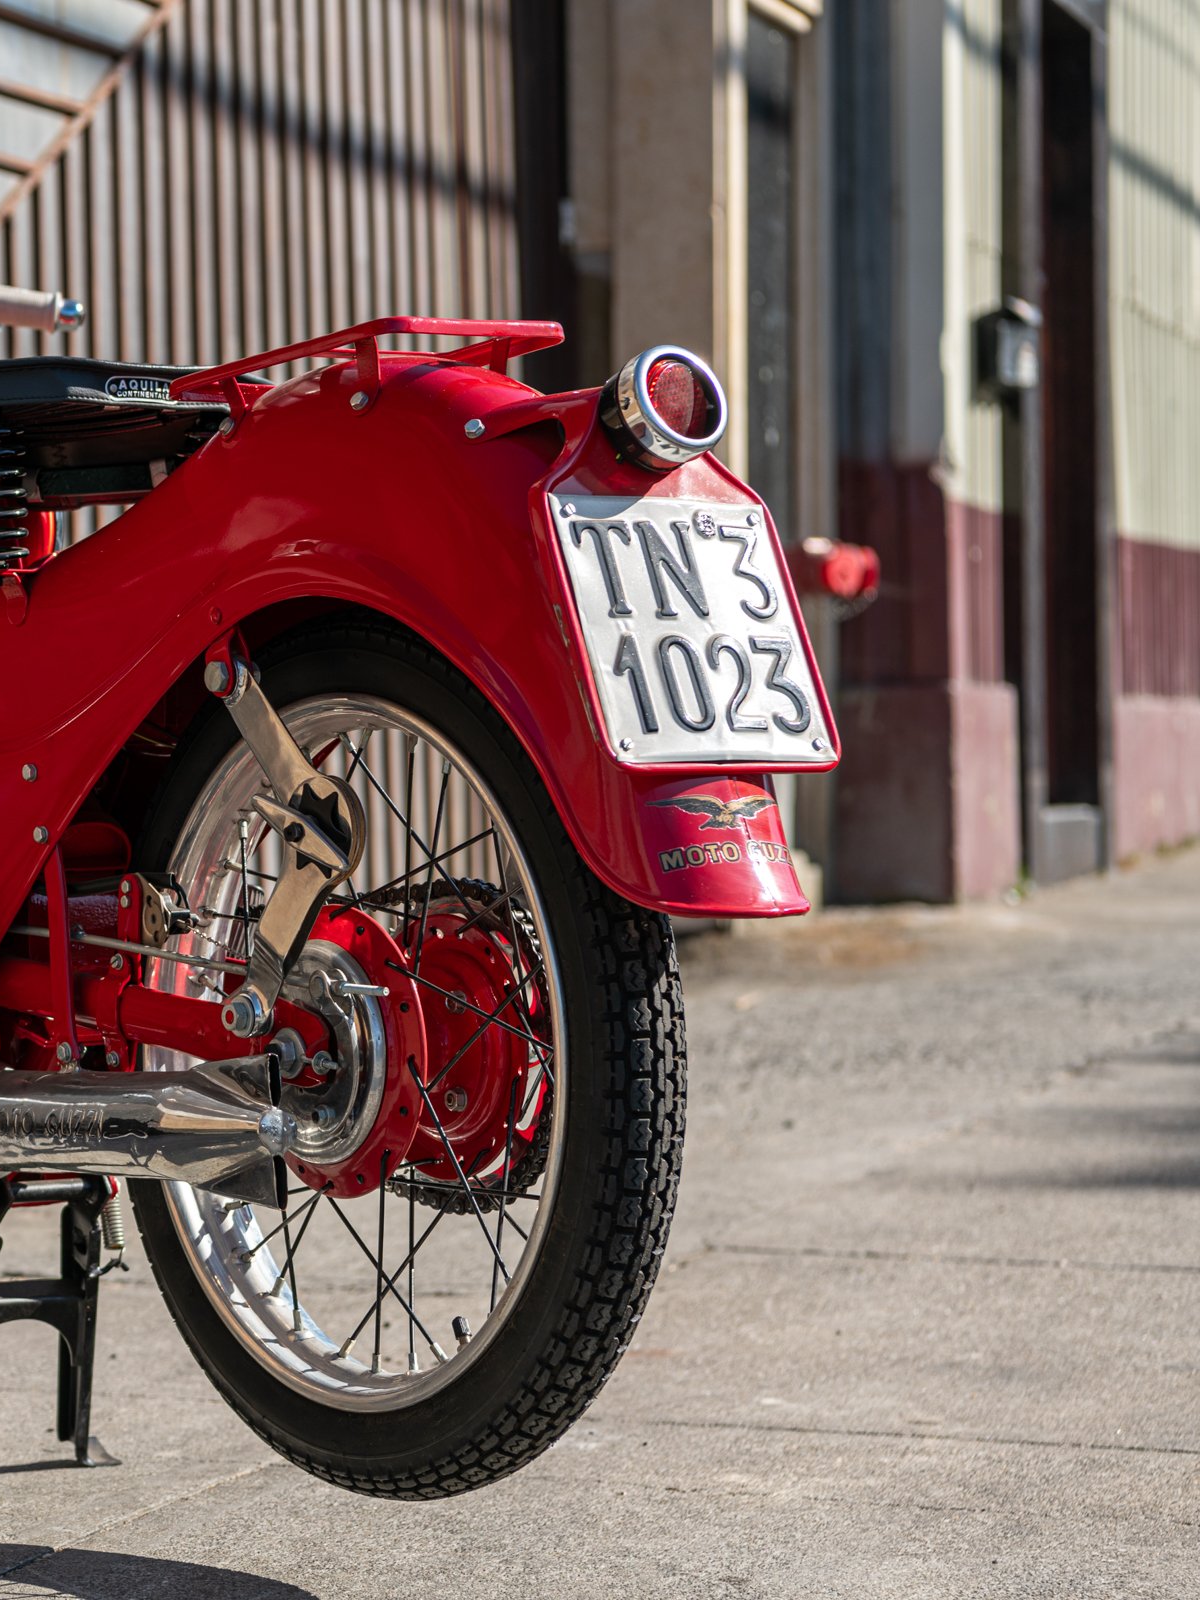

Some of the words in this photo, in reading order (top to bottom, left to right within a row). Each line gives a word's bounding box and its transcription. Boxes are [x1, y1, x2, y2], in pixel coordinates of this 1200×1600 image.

[116, 390, 170, 400] CONTINENTALE
[119, 379, 170, 392] AQUILA
[569, 520, 710, 618] TN
[718, 525, 778, 622] 3
[613, 633, 812, 734] 1023
[659, 842, 740, 873] MOTO
[746, 841, 794, 866] GUZZ
[44, 1108, 104, 1141] GUZZI
